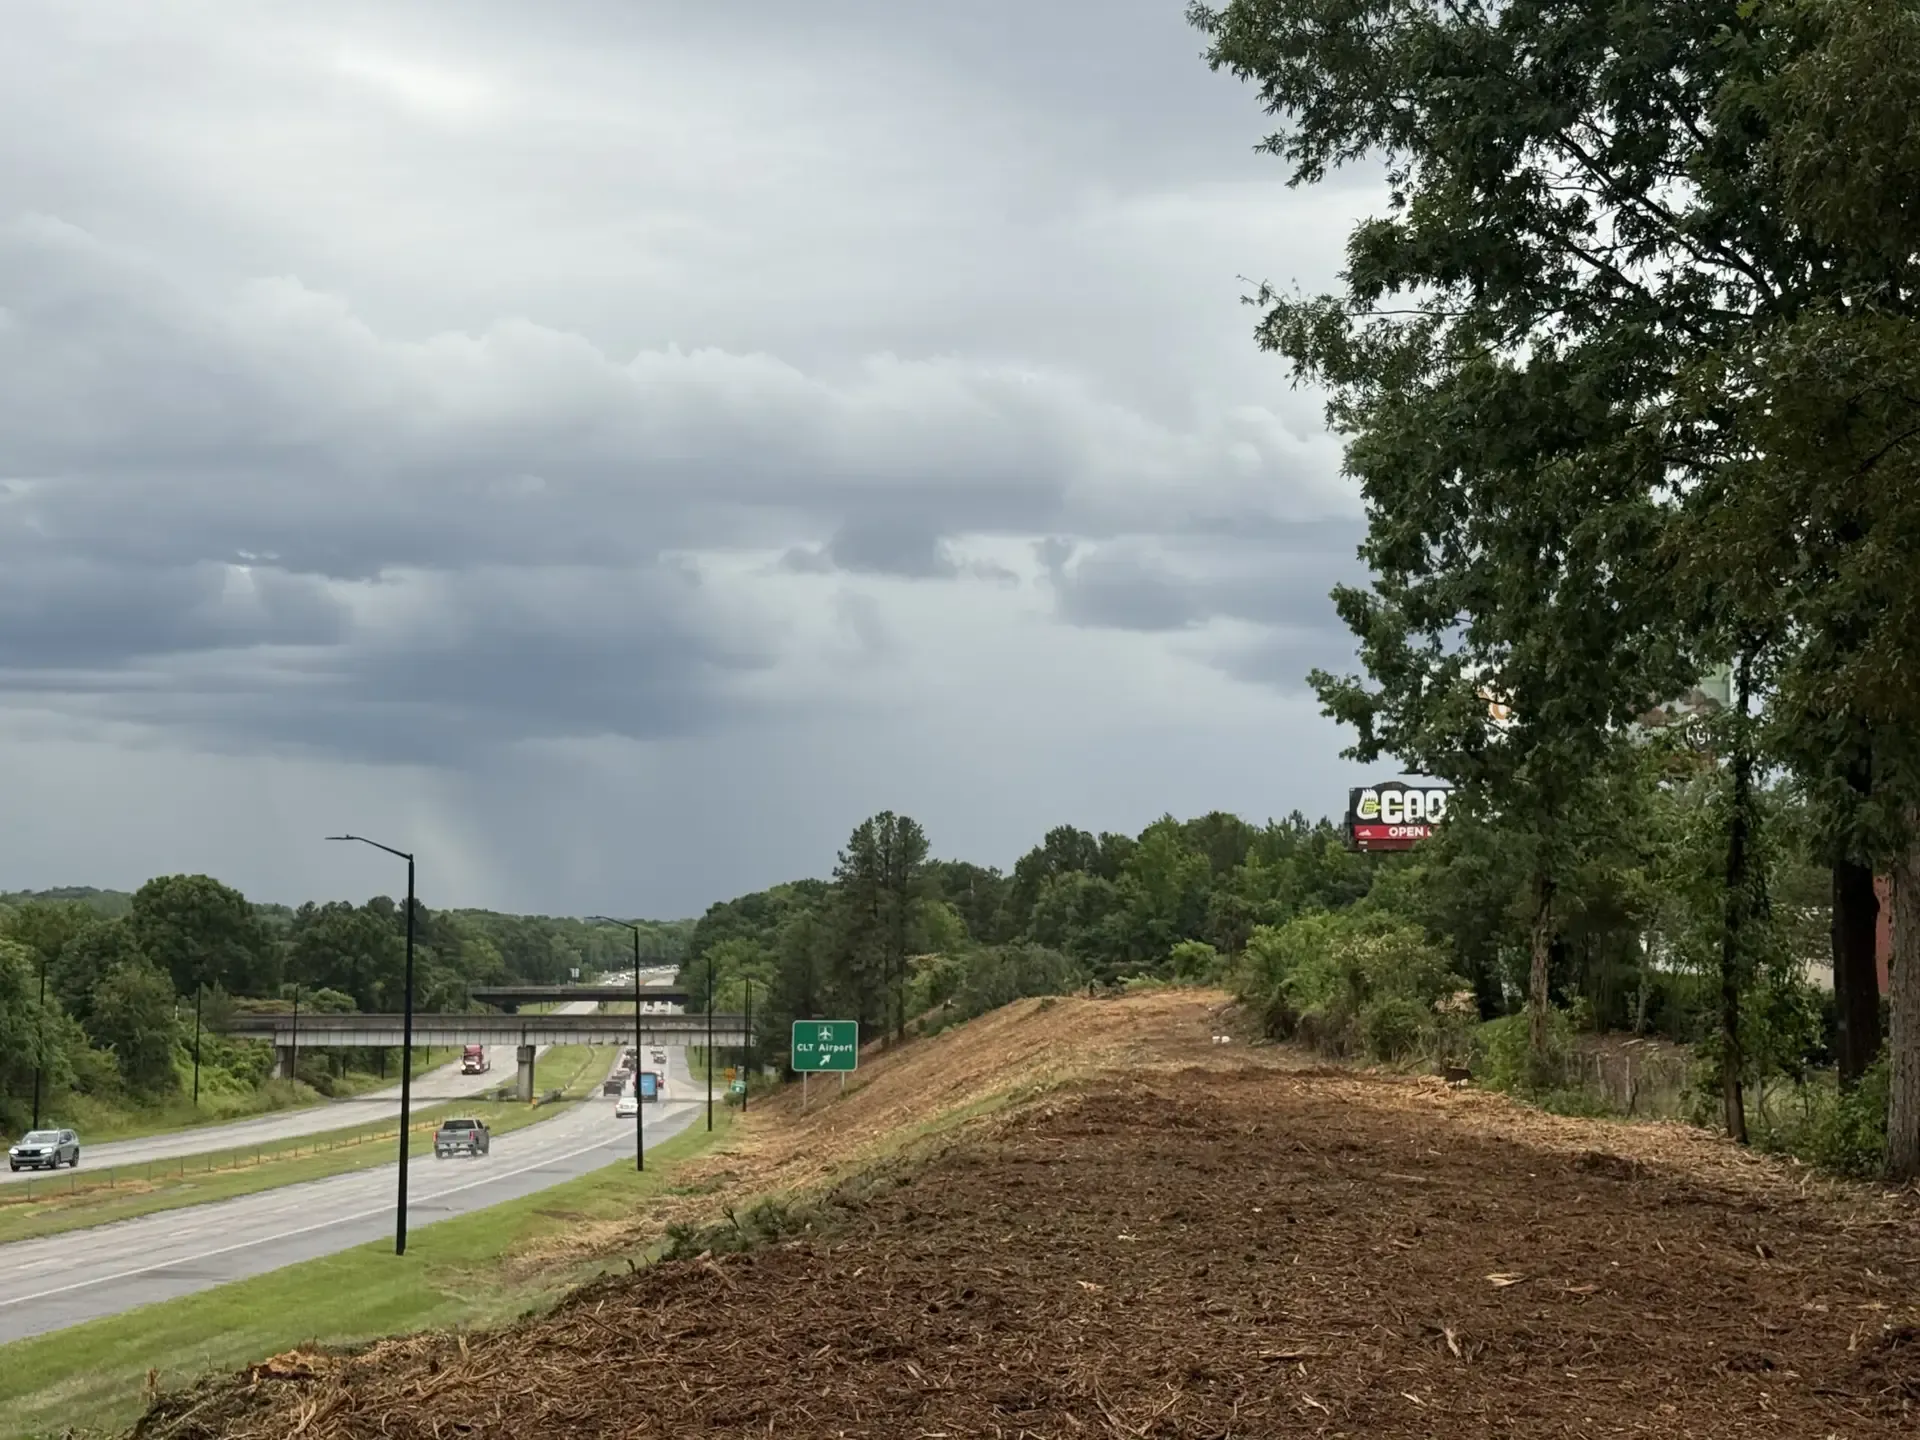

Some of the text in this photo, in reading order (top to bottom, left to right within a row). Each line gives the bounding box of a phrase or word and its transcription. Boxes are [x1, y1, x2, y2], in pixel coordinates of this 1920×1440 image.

[1381, 790, 1456, 824] COO
[1388, 826, 1424, 837] OPEN
[797, 1043, 853, 1053] CLT Airport
